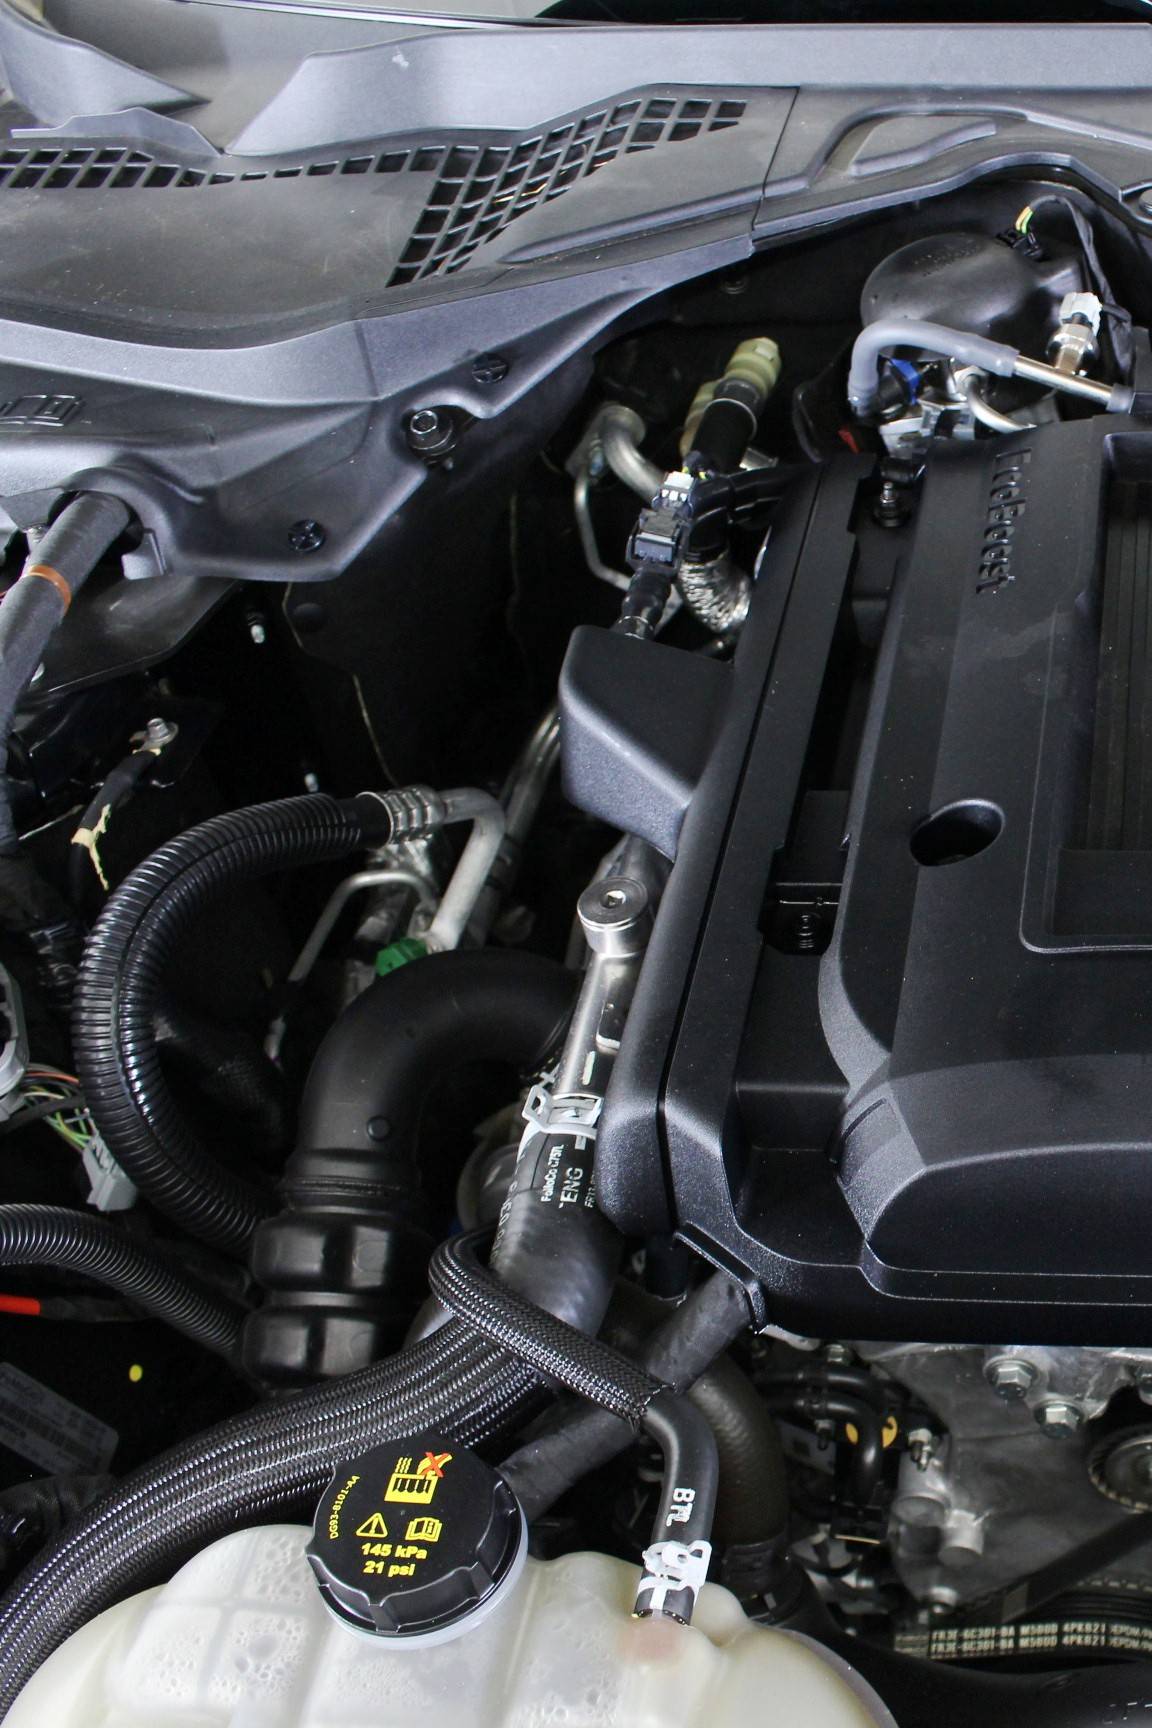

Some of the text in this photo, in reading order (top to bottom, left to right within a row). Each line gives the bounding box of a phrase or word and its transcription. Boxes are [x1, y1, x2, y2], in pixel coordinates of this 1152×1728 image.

[560, 1167, 584, 1203] ENG
[361, 1542, 428, 1559] 145 kPa
[363, 1560, 416, 1577] 21 psi
